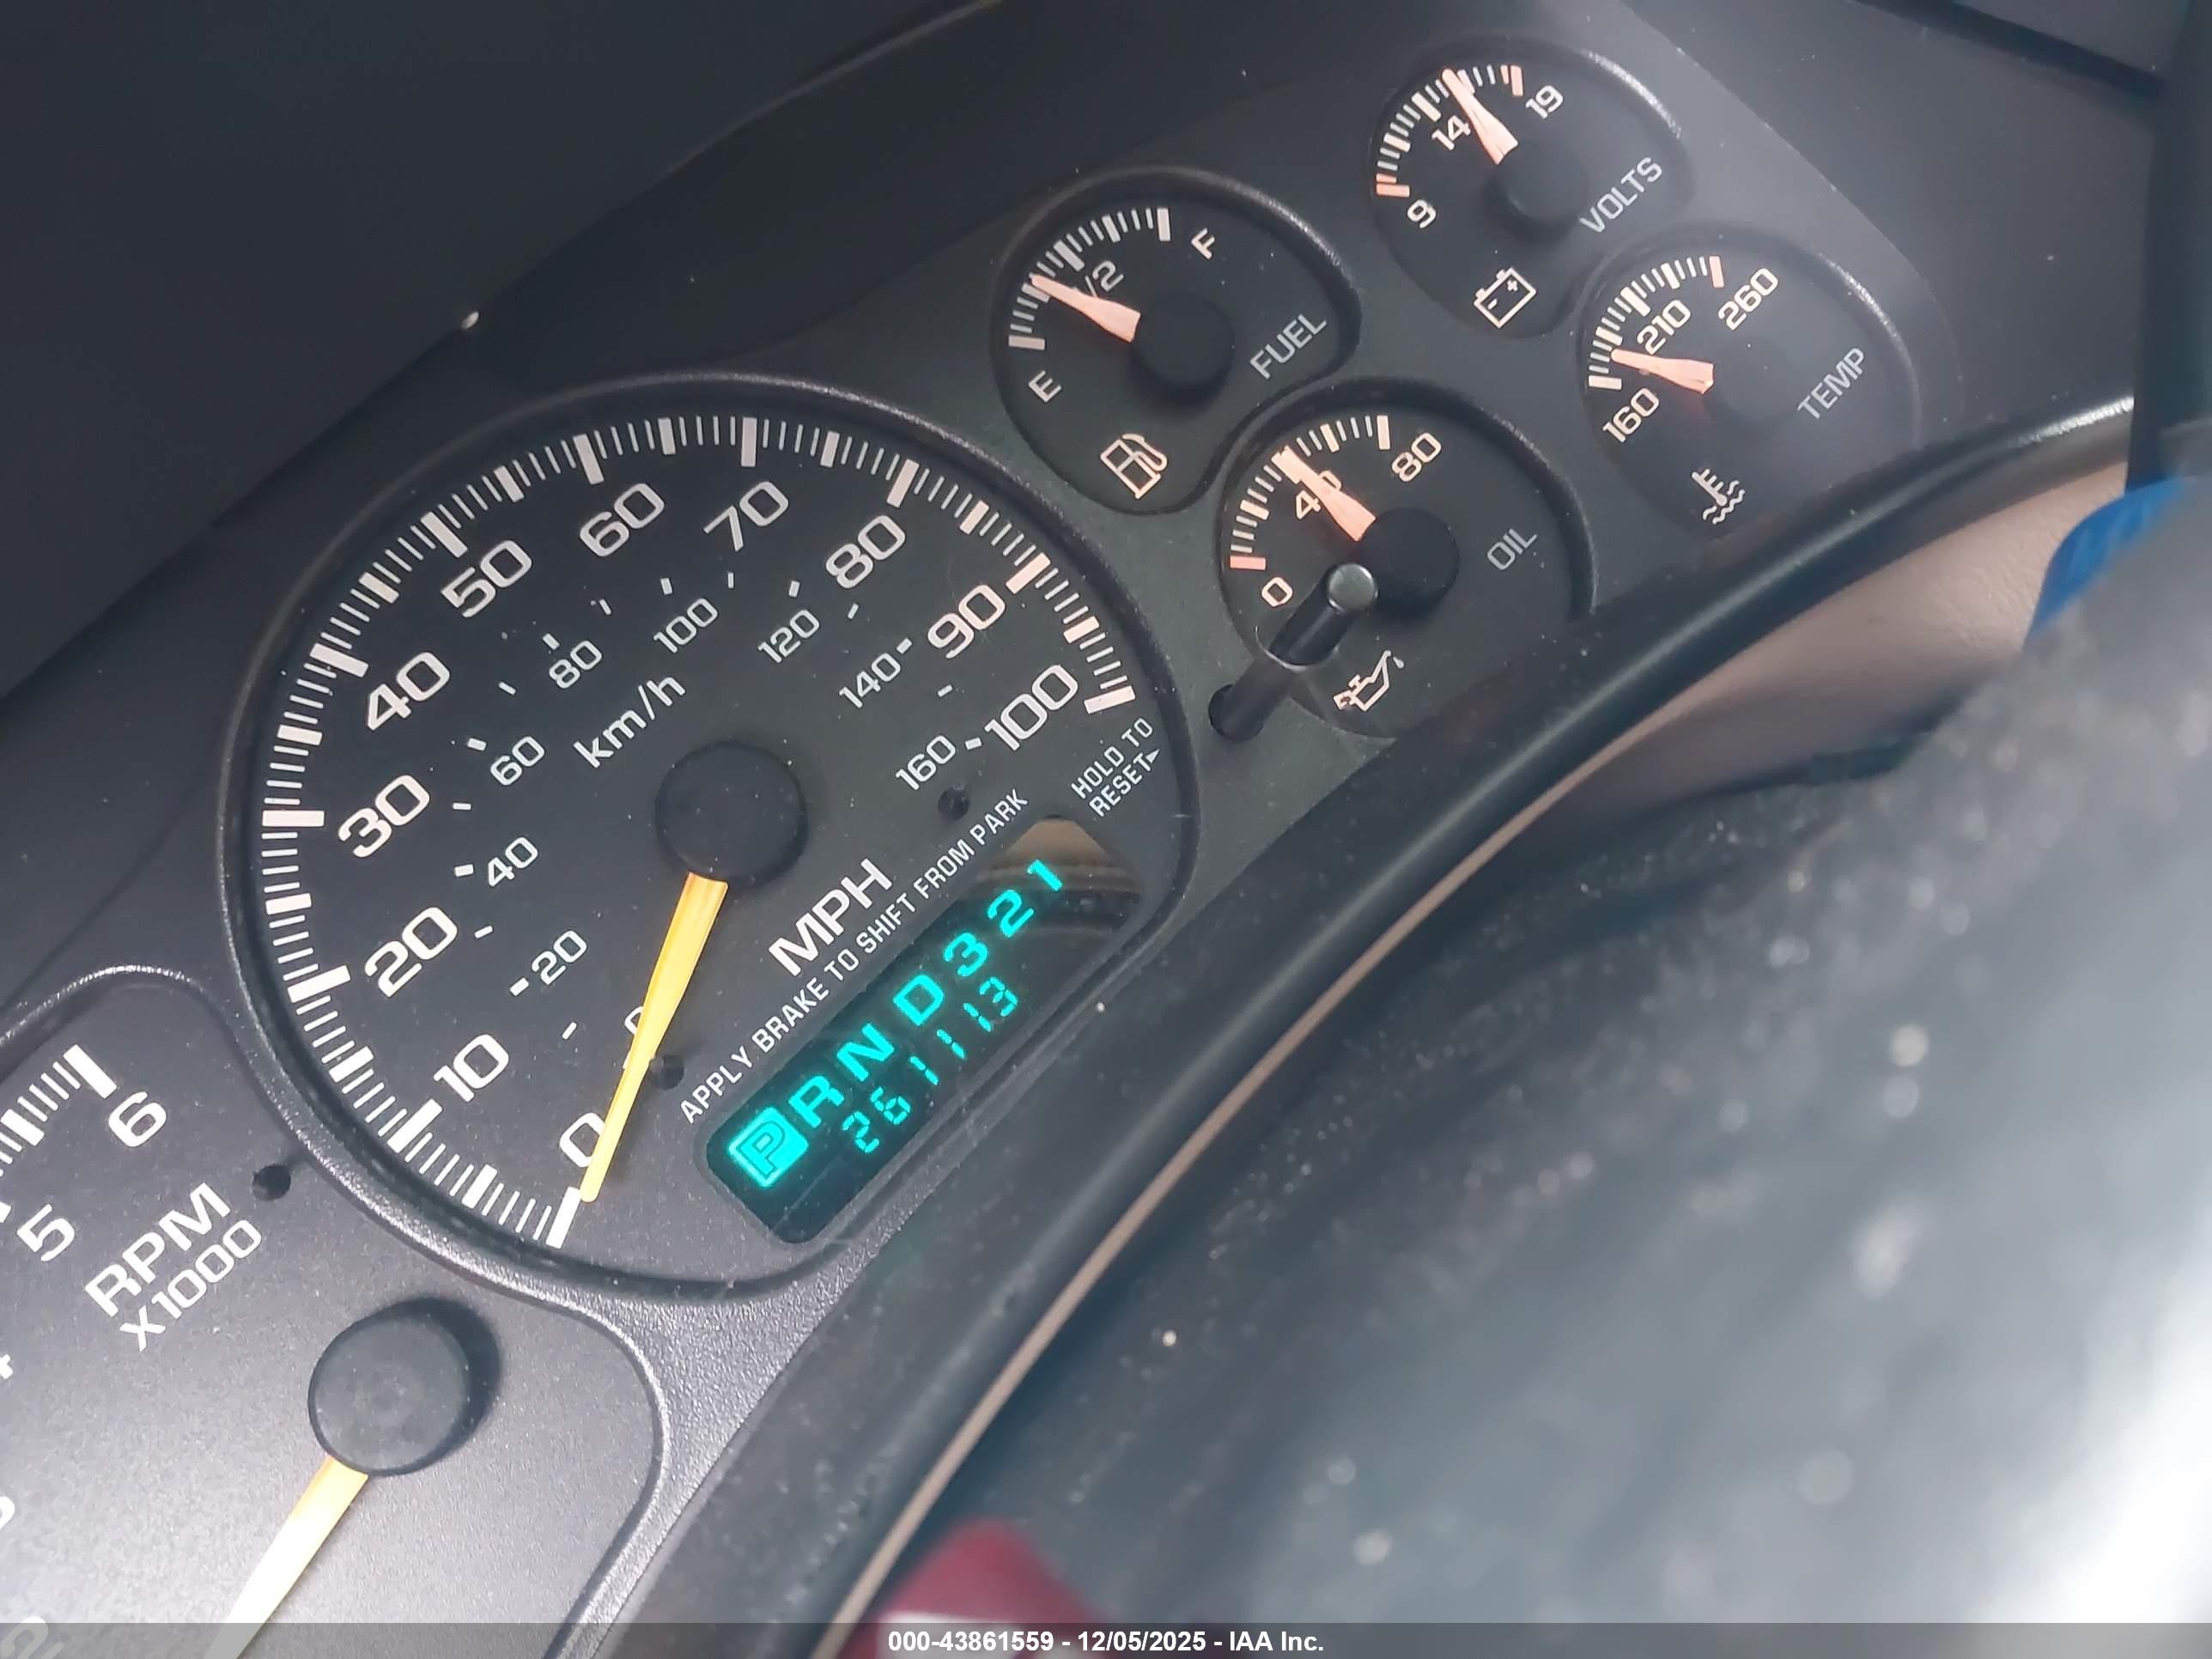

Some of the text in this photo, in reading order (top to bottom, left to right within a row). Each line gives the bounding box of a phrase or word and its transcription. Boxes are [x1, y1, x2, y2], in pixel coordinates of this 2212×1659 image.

[1431, 114, 1472, 151] 14
[1525, 84, 1565, 119] 19
[1407, 199, 1437, 229] 9
[1578, 156, 1663, 234] VOLTS
[1191, 228, 1215, 259] F
[1073, 260, 1124, 298] /2
[1717, 268, 1779, 331] 260
[1250, 313, 1327, 380] FUEL
[1636, 299, 1692, 356] 210
[1029, 370, 1061, 402] E
[1601, 387, 1660, 443] 160
[1797, 347, 1868, 421] TEMP
[1391, 432, 1442, 482] 80
[579, 483, 665, 556] 60
[704, 480, 789, 550] 70
[441, 539, 532, 617] 50
[825, 514, 906, 588] 80
[1486, 528, 1538, 572] OIL
[927, 584, 1005, 659] 90
[1261, 577, 1293, 607] 0
[653, 599, 717, 653] 100
[757, 609, 820, 664] 120
[365, 651, 451, 731] 40
[548, 640, 603, 689] 80
[838, 651, 902, 709] 140
[573, 673, 685, 769] km/h
[985, 665, 1079, 751] 100
[489, 735, 544, 787] 60
[896, 735, 956, 791] 160
[1072, 718, 1152, 799] HOLD TO
[1090, 752, 1152, 817] RESET
[339, 774, 430, 859] 30
[486, 836, 538, 888] 40
[769, 859, 892, 976] MPH
[364, 906, 457, 997] 20
[531, 930, 587, 985] 20
[680, 788, 1028, 1124] APPLY BRAKE TO SHIFT FROM PARK
[735, 860, 1062, 1180] P R N D 3 2 1
[434, 1035, 509, 1103] 10
[842, 976, 1018, 1153] 261113
[109, 1092, 167, 1147] 6
[560, 1113, 605, 1168] 0
[17, 1204, 75, 1261] 5
[84, 1182, 233, 1316] RPM
[119, 1219, 262, 1351] X1000
